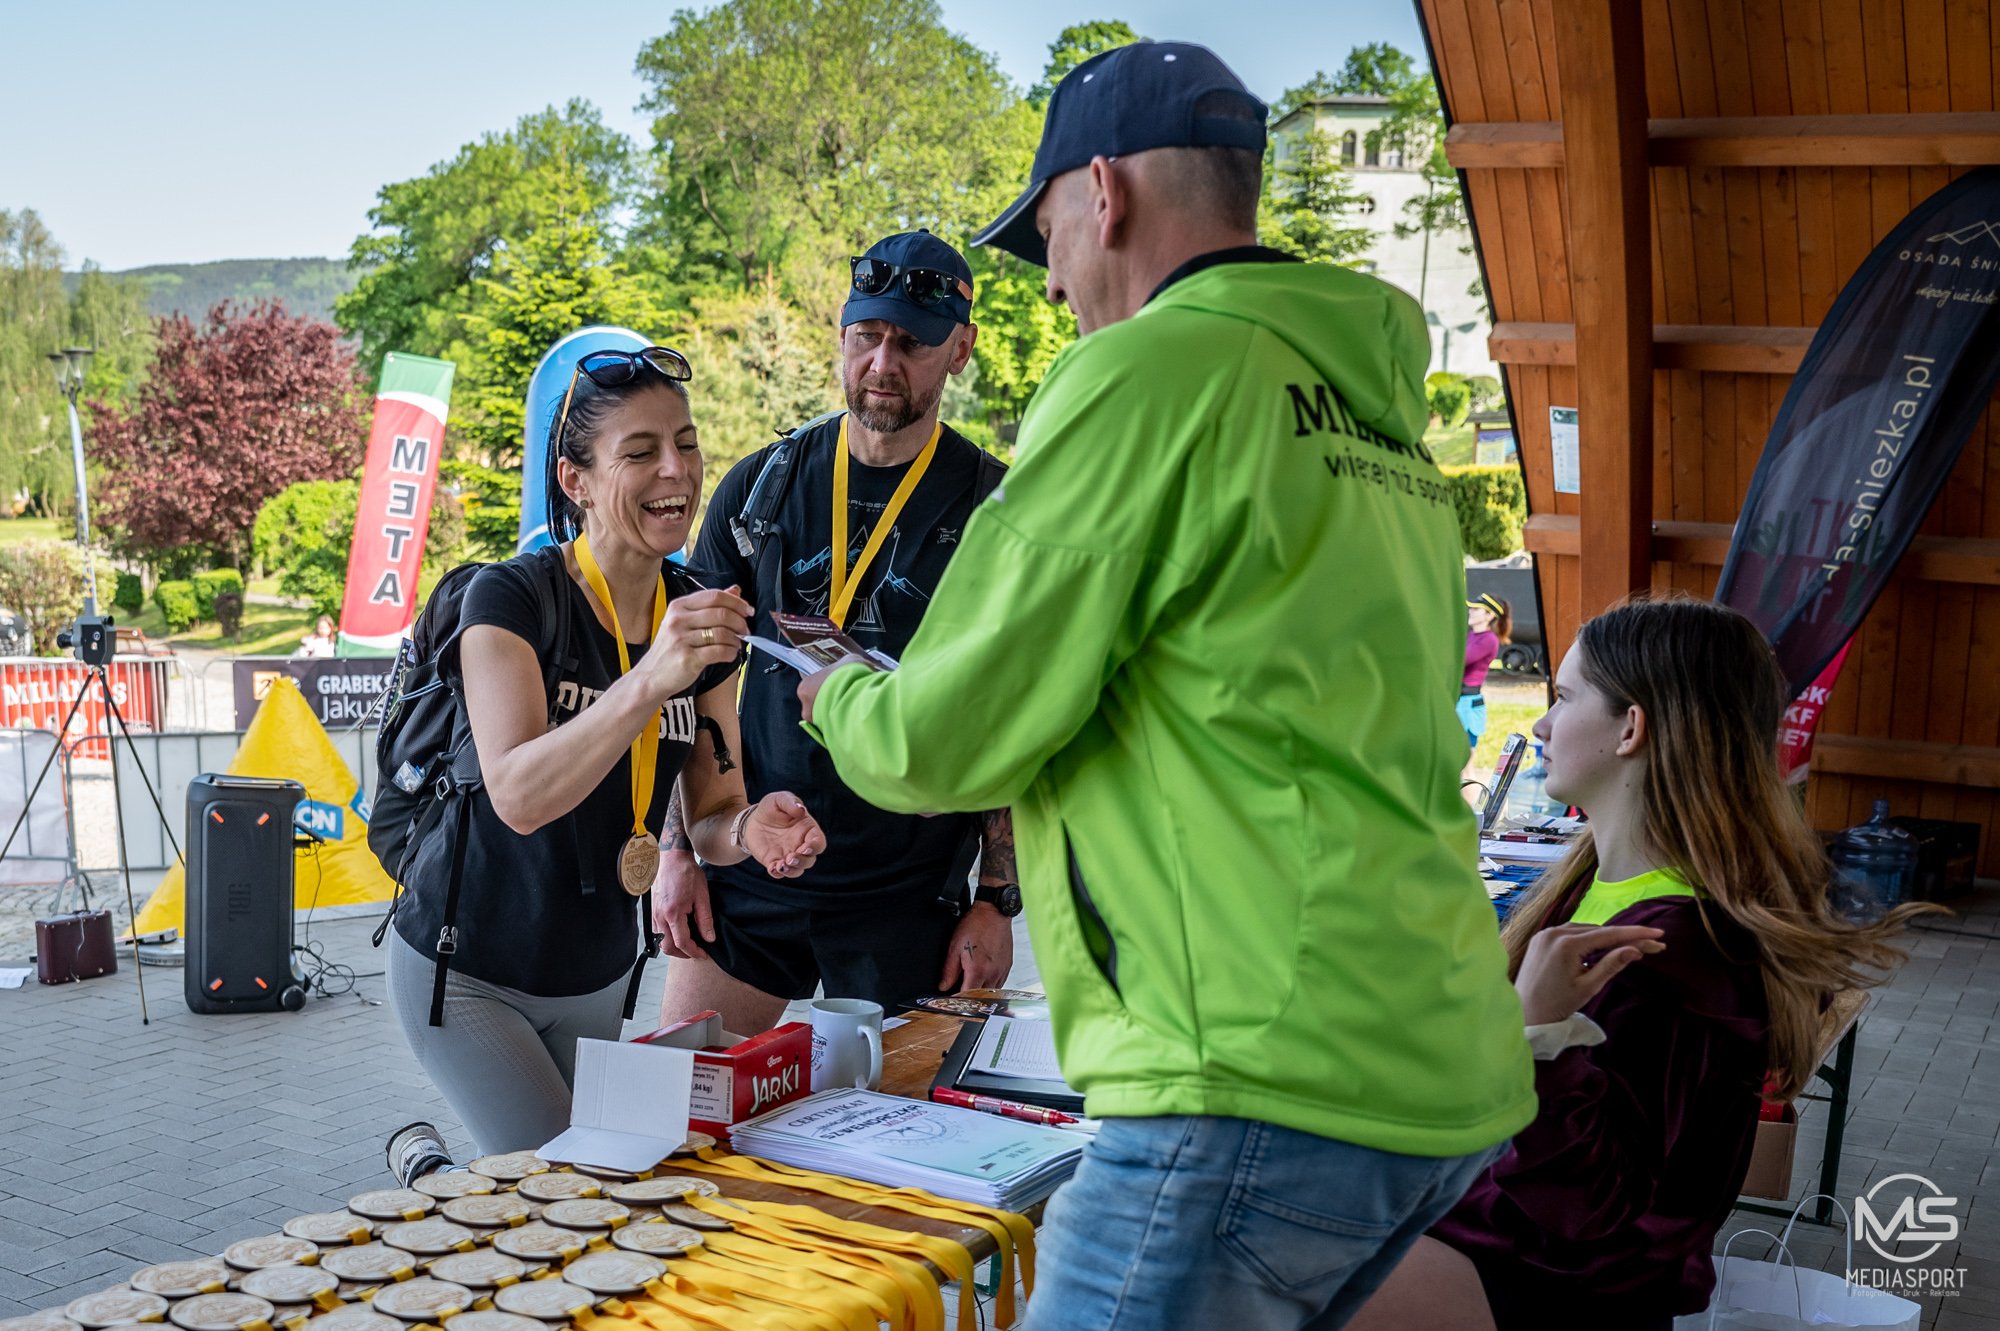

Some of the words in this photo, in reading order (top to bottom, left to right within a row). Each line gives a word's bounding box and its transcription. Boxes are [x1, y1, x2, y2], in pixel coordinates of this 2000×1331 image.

[1899, 250, 1962, 268] OSADA
[1970, 255, 2000, 273] ŚNI
[1324, 447, 1390, 495] więcej
[788, 1099, 869, 1127] CERTYFIKAT
[819, 1104, 923, 1140] SZWENDACZKA
